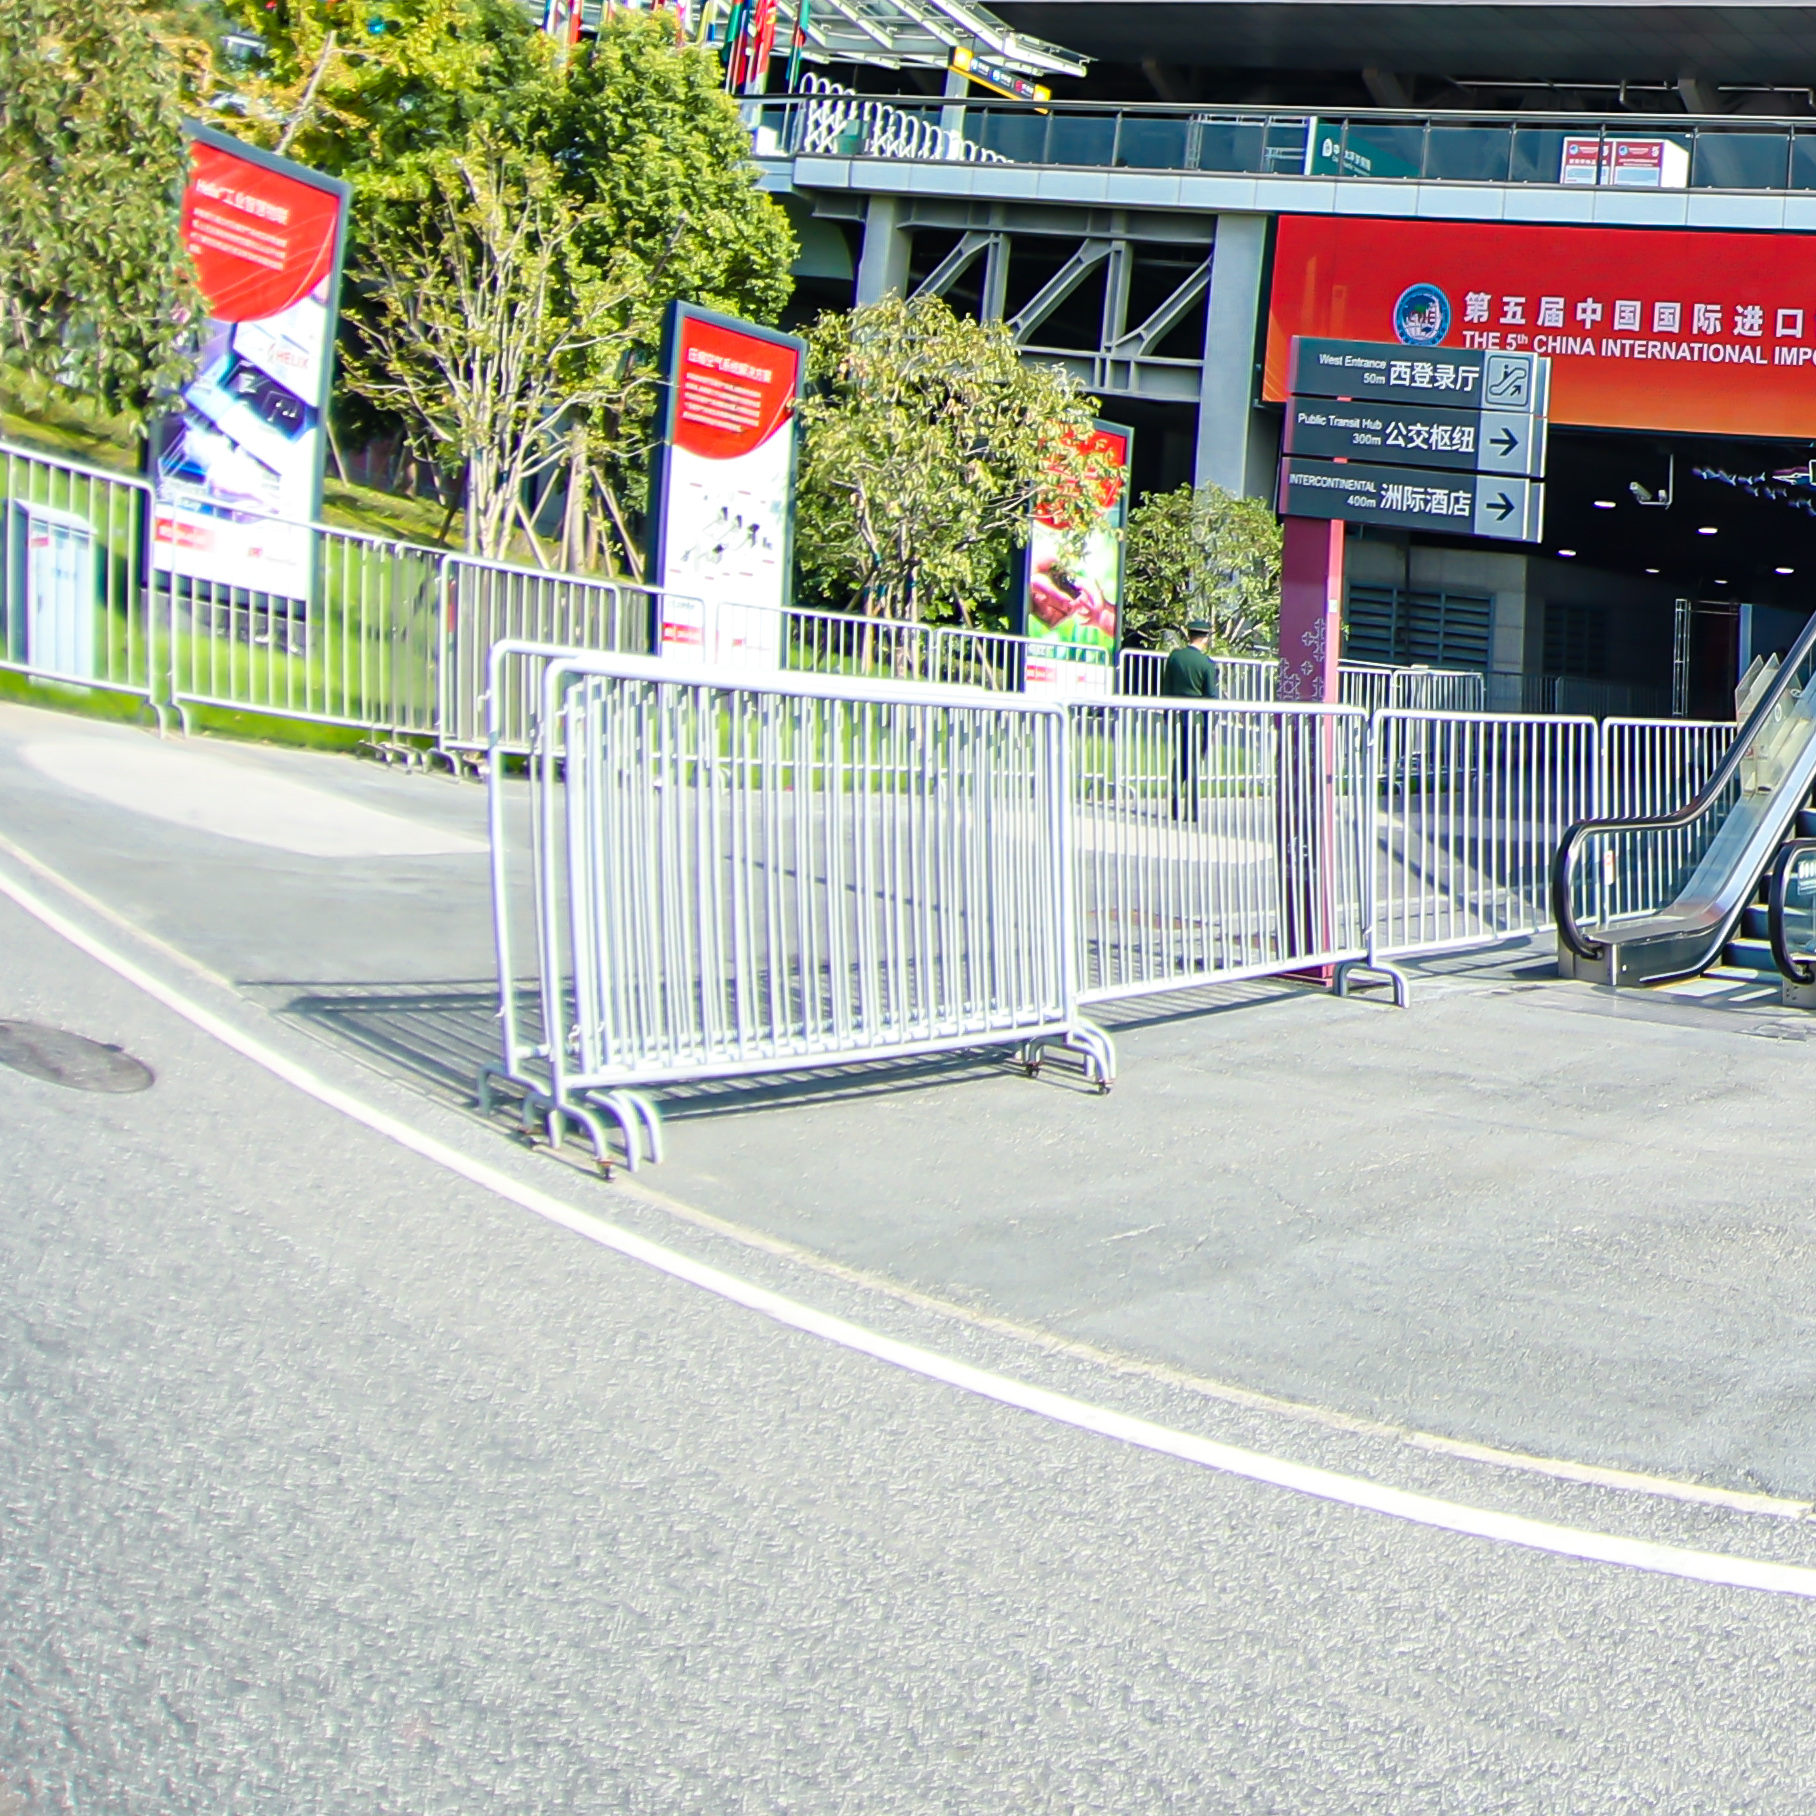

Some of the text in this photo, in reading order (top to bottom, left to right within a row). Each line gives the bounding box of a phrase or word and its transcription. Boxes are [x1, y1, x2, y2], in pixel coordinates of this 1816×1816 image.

[1462, 331, 1501, 350] THE
[1506, 333, 1529, 351] 5th
[1533, 335, 1596, 356] CHINA
[1601, 338, 1768, 365] INTERNATIONAL
[1319, 353, 1387, 370] West Entrance
[1363, 372, 1386, 385] 50m
[1389, 360, 1480, 392] 西登录厅
[1297, 412, 1383, 430] Public Transit Hub
[1352, 433, 1381, 446] 300m
[1385, 421, 1476, 453] 公交枢纽
[1289, 473, 1377, 493] INTERCONTINENTAL
[1347, 495, 1377, 508] 400m
[1379, 483, 1472, 517] 洲际酒店
